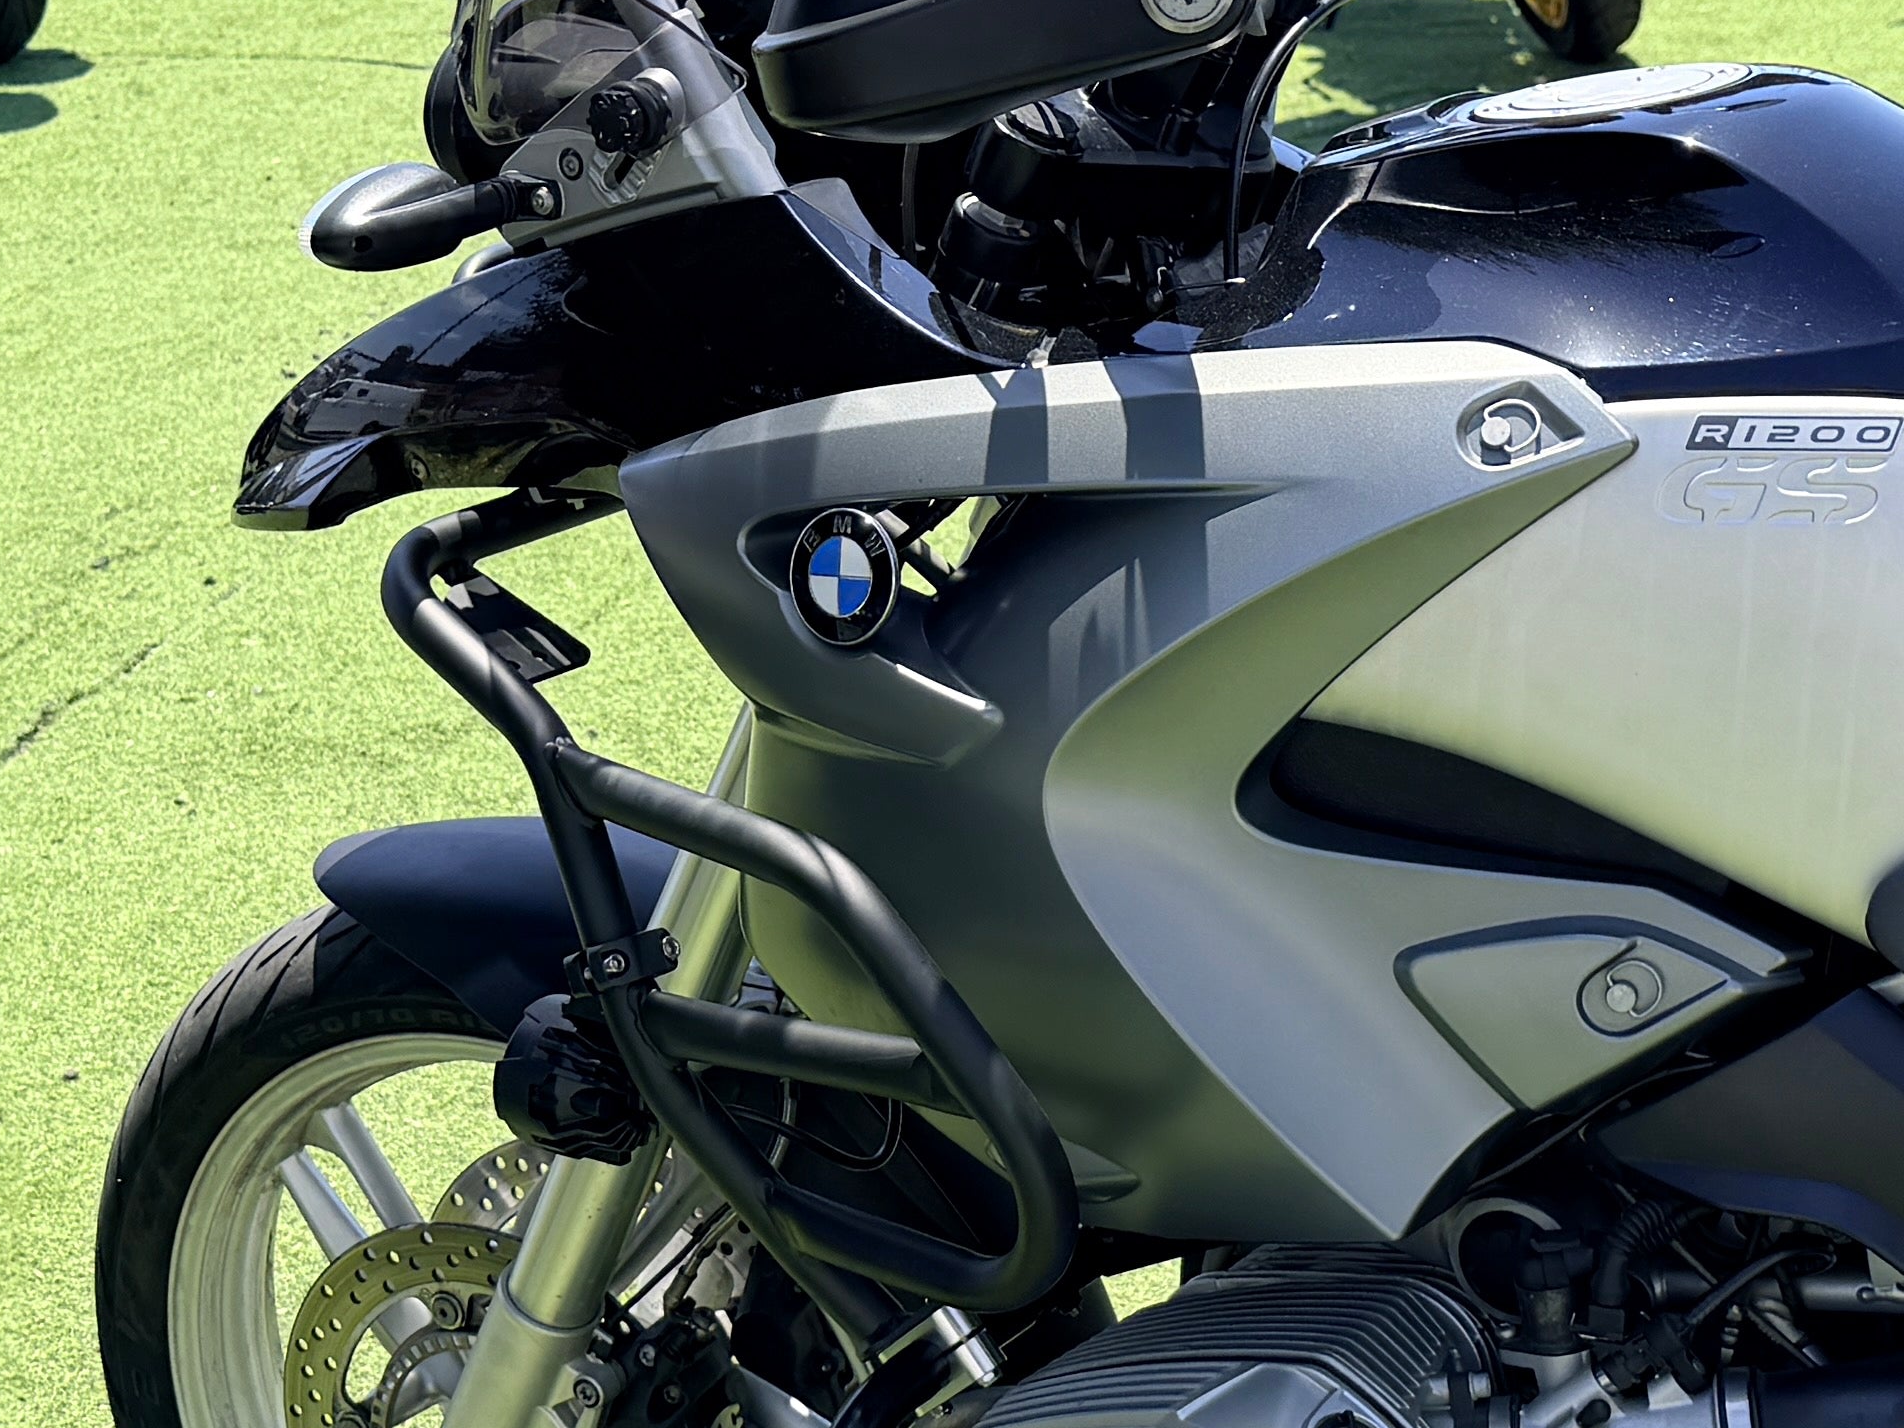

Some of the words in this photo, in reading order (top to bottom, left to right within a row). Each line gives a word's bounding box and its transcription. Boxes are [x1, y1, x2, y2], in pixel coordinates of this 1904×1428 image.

[1694, 424, 1892, 444] R1200
[1657, 456, 1889, 523] GS
[803, 514, 886, 558] BMW
